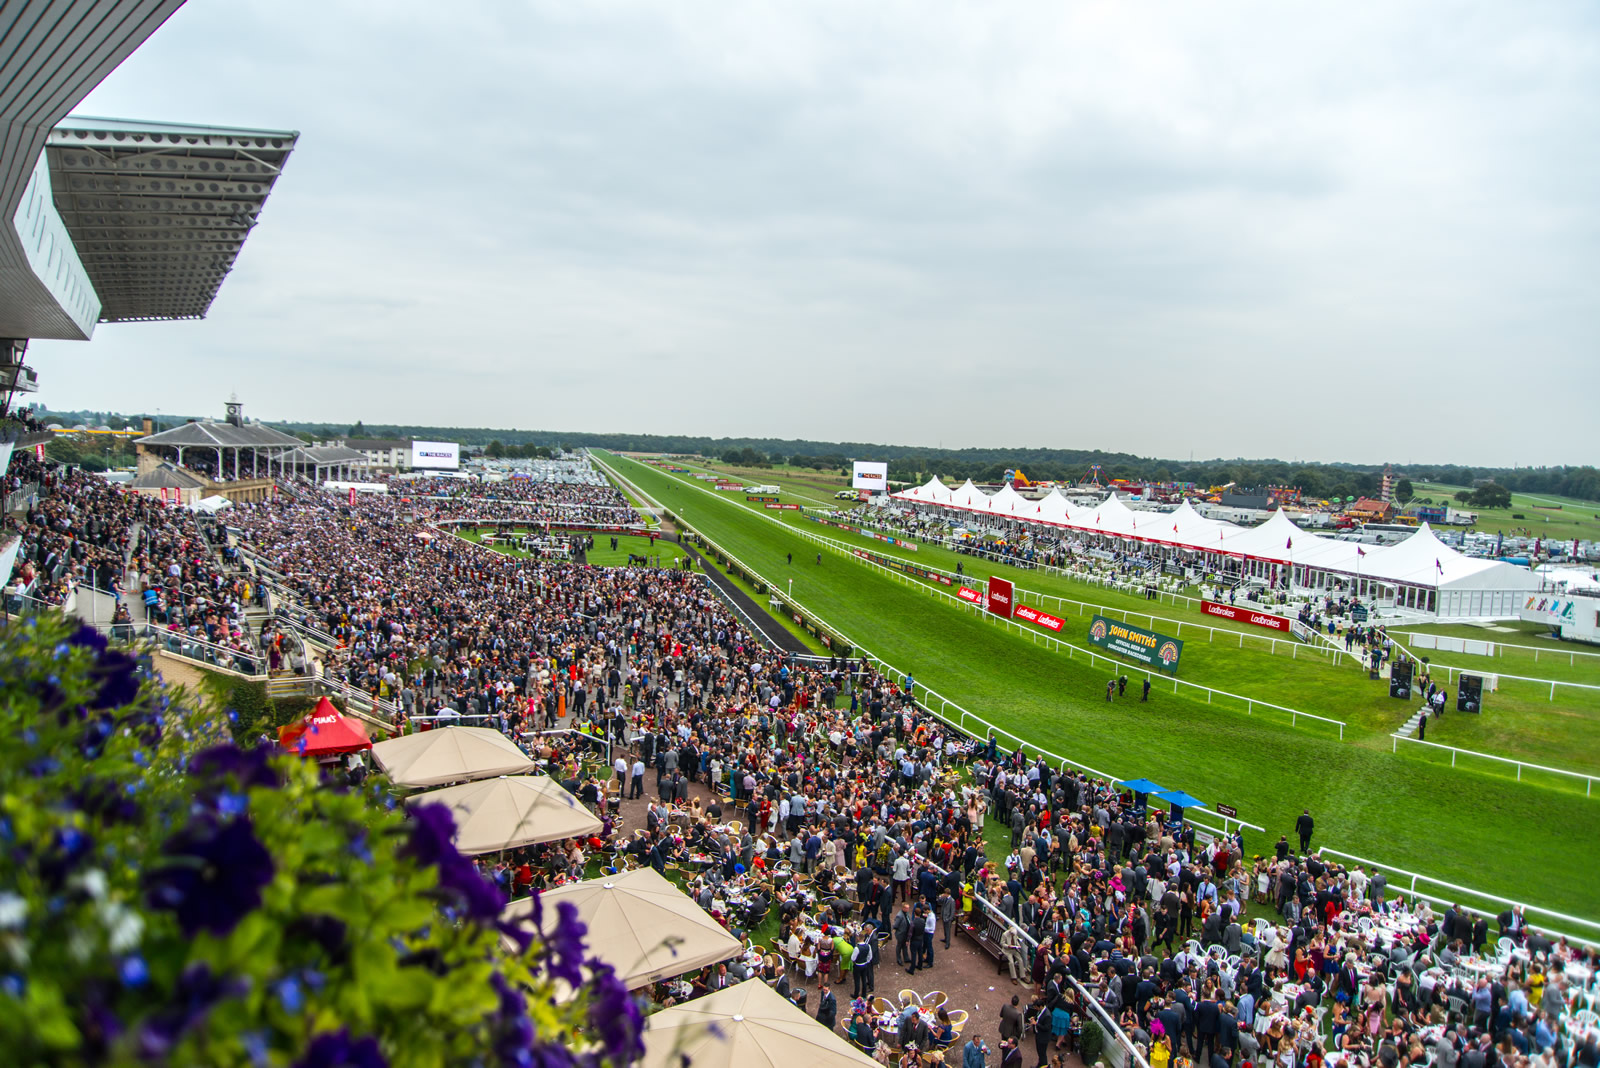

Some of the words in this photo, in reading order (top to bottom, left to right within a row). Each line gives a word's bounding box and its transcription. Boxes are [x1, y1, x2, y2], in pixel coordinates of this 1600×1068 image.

[991, 590, 1009, 604] Ladbrokes
[1016, 606, 1037, 620] Ladbrokes
[1038, 614, 1060, 628] Ladbrokes
[1208, 604, 1235, 618] Ladbrokes
[1250, 613, 1280, 628] Ladbrokes
[1109, 624, 1129, 640] JOHN
[1128, 634, 1157, 649] SMITH'S
